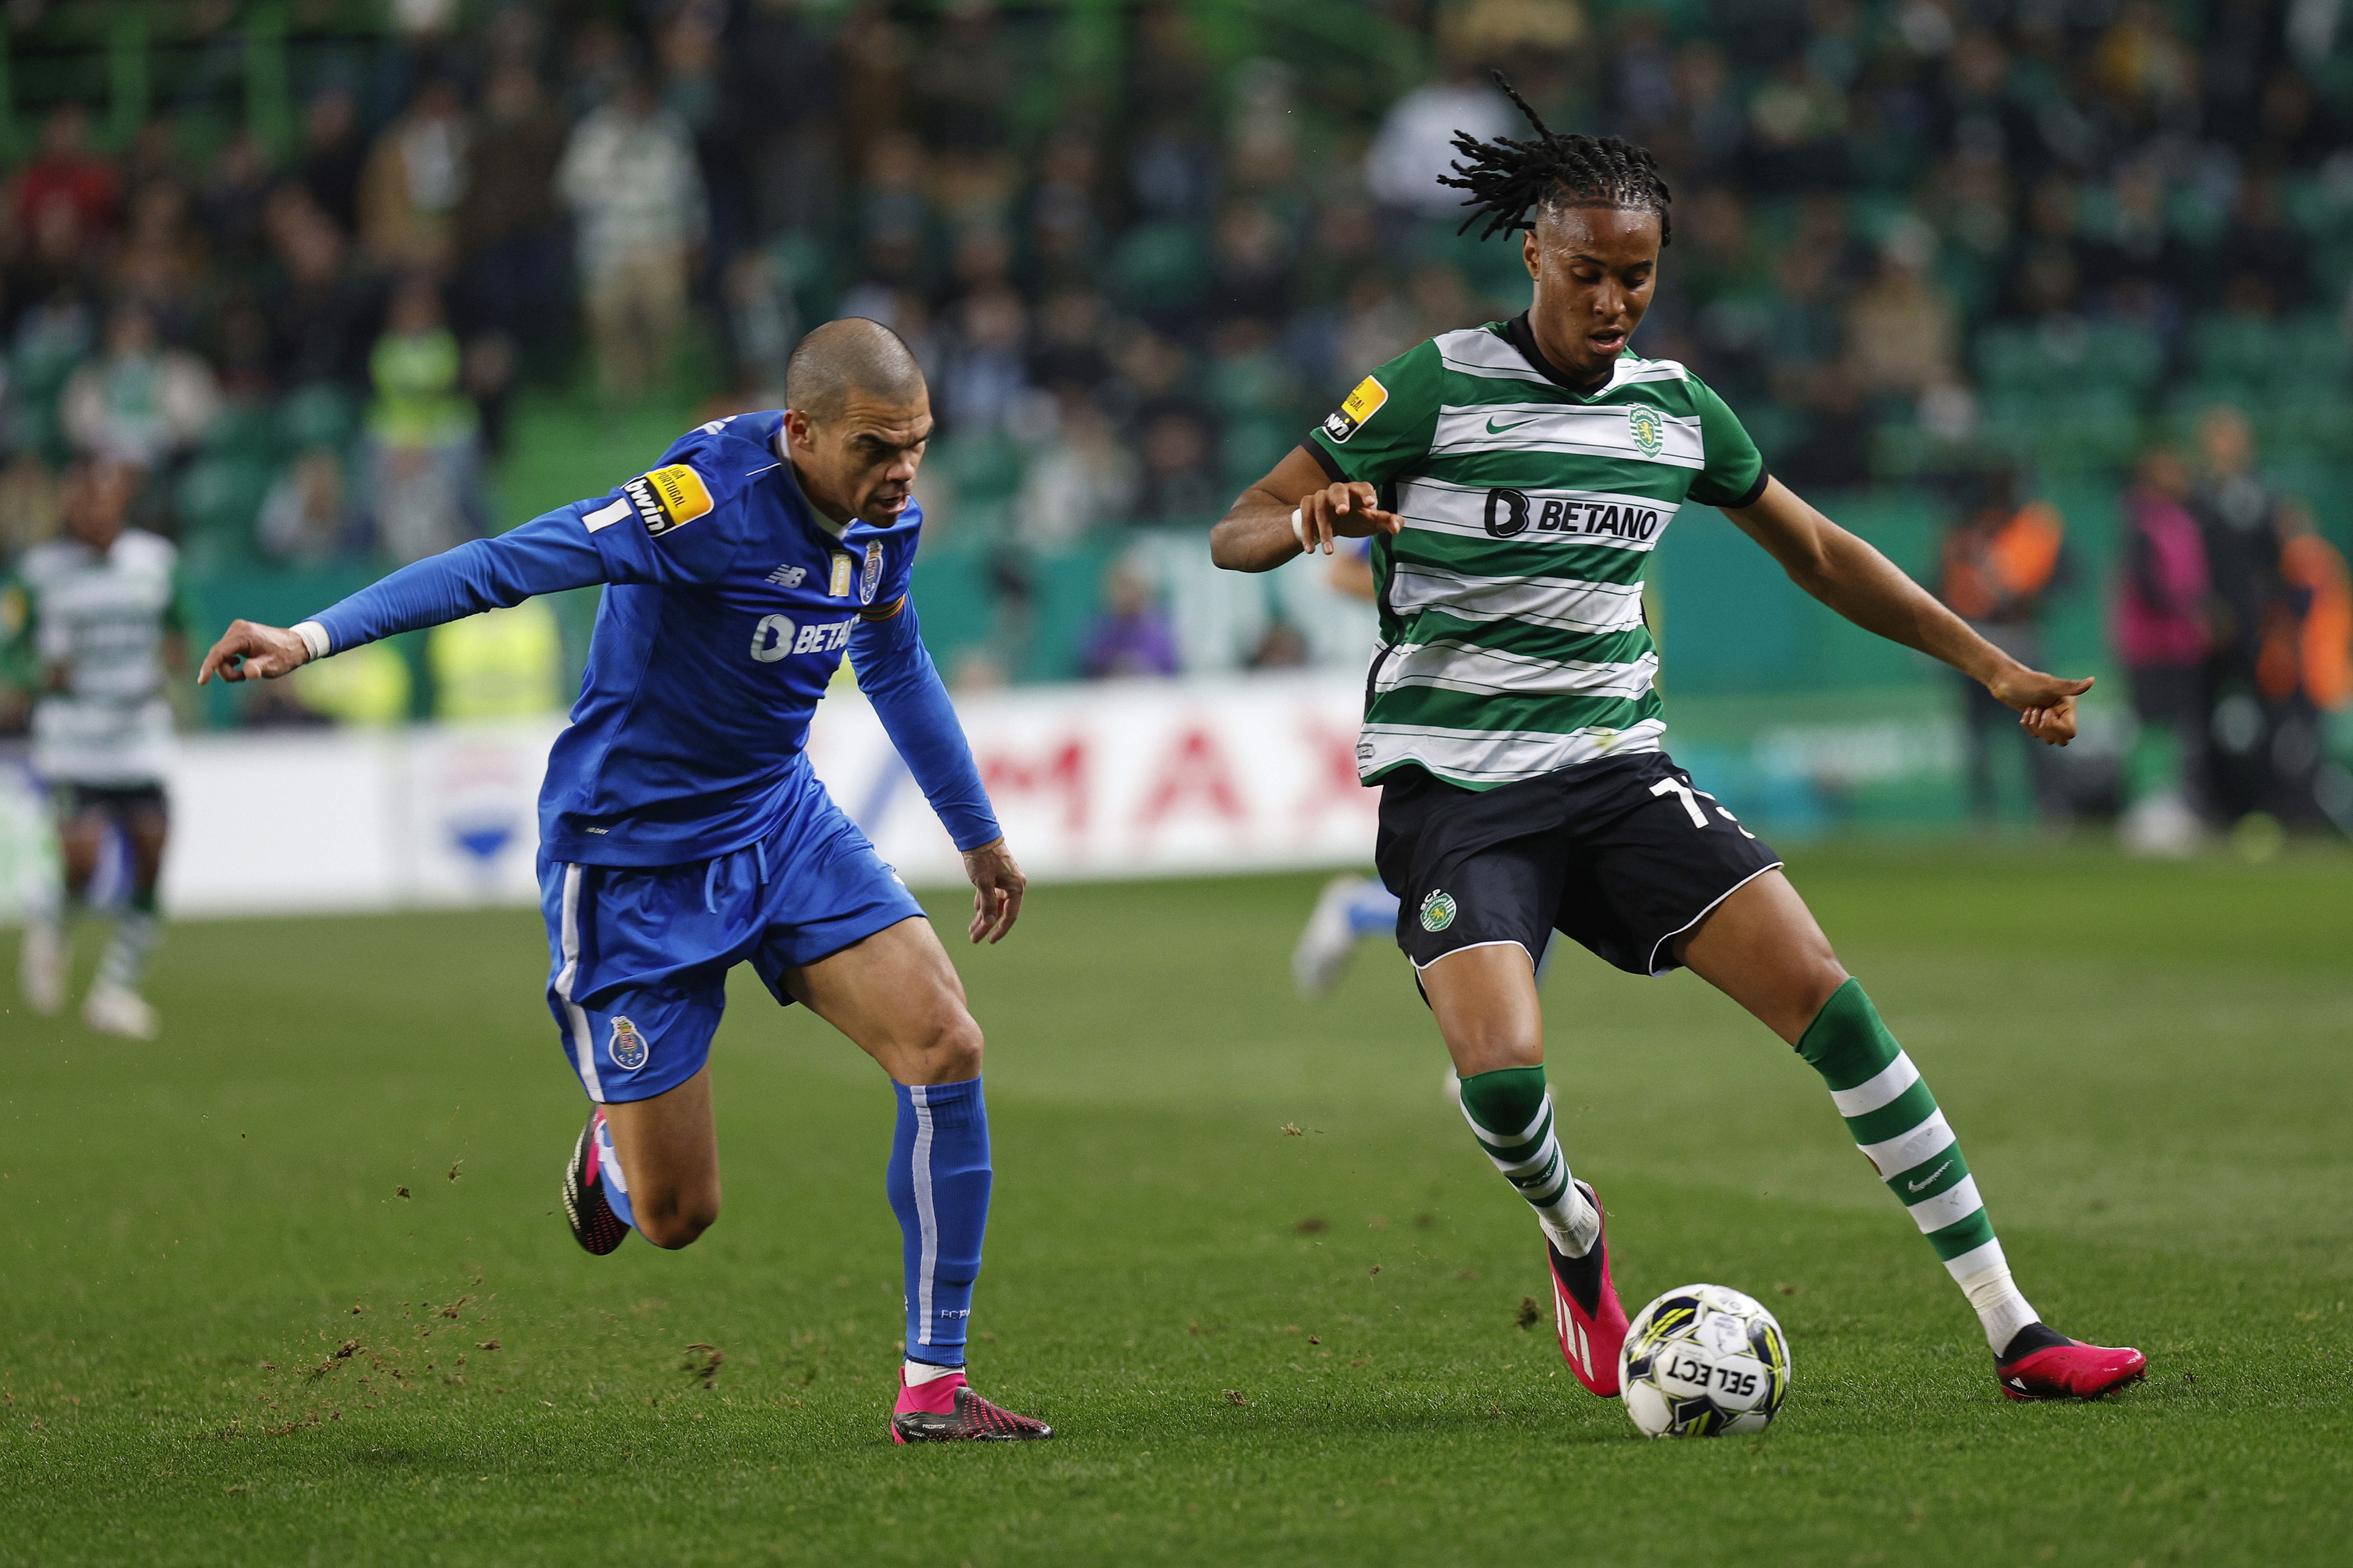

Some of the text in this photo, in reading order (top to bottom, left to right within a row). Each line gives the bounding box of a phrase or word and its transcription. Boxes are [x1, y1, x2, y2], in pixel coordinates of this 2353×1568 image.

[1324, 413, 1350, 436] win
[655, 471, 686, 509] PORTUGAL
[668, 466, 686, 480] LIGA
[624, 478, 665, 532] bwin
[1538, 501, 1657, 540] BETANO
[792, 613, 861, 654] BETA
[1420, 888, 1441, 910] SCP
[1424, 898, 1447, 919] SPORTING
[1667, 1356, 1757, 1397] SELECT
